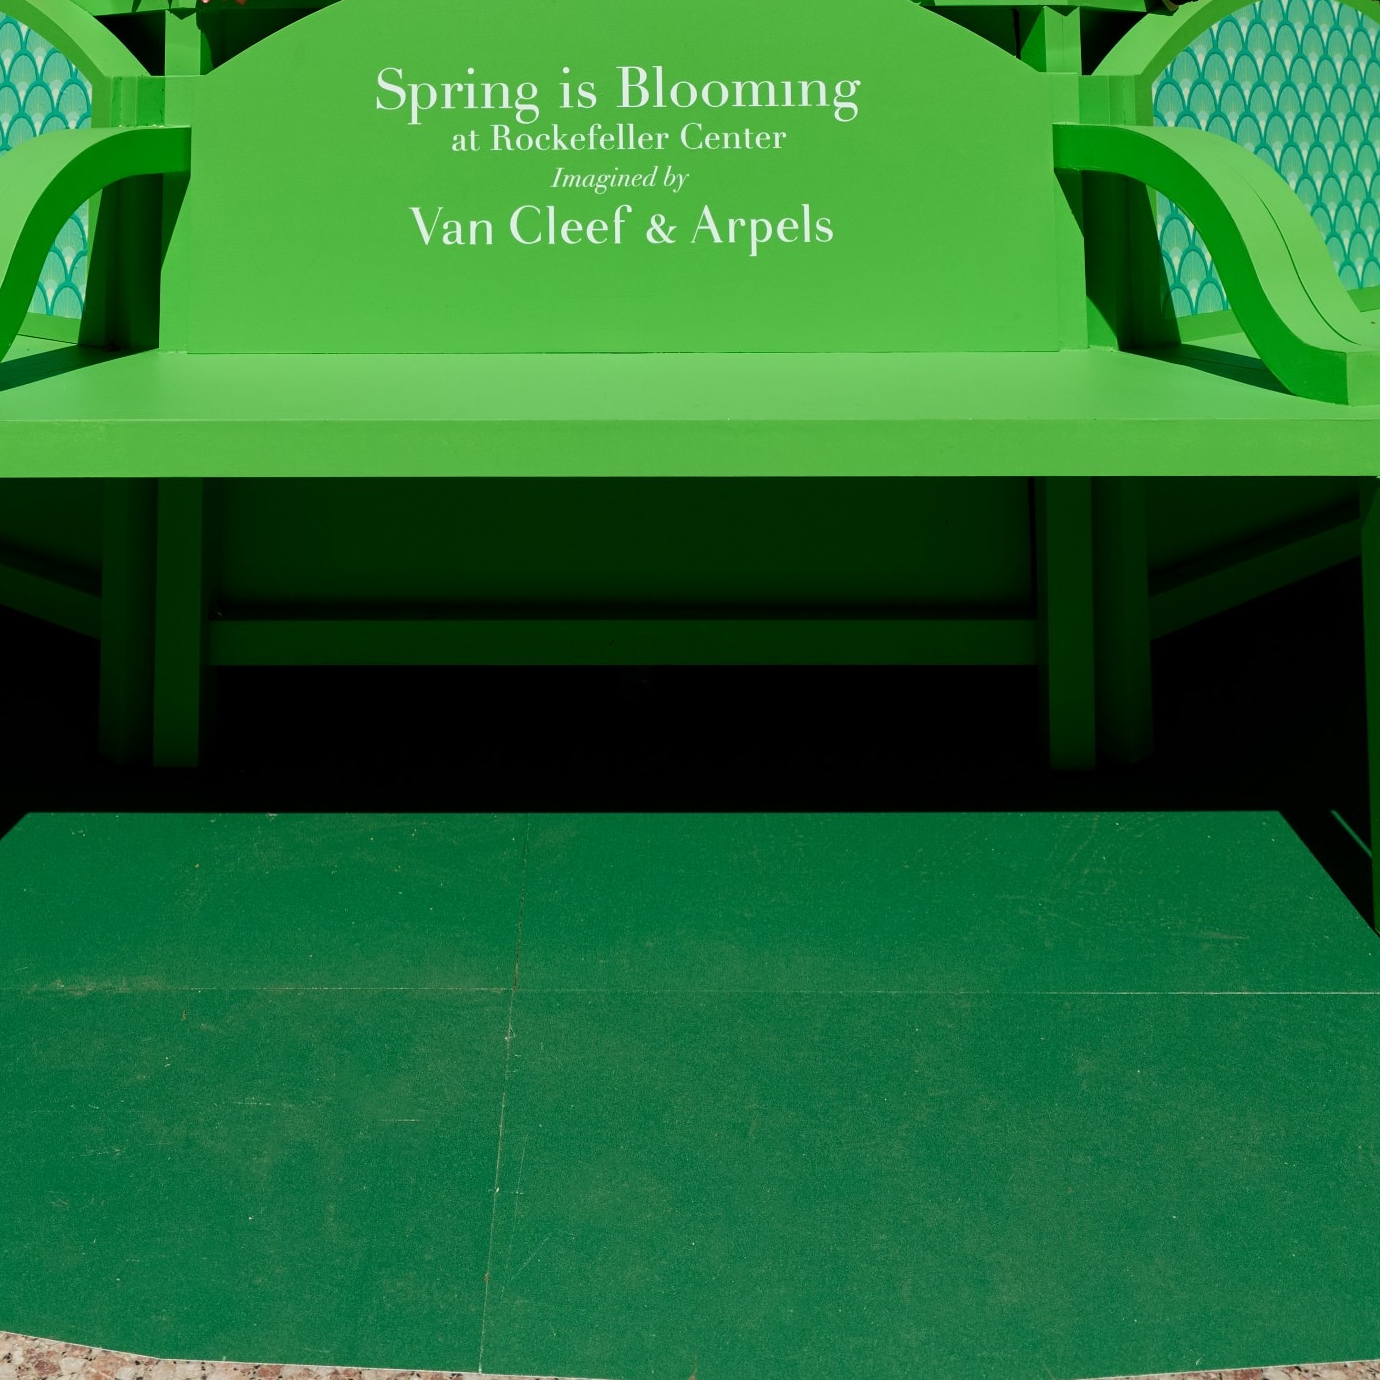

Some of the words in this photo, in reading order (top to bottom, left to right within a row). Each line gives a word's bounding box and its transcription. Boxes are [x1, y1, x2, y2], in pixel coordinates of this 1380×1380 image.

[376, 66, 540, 125] Spring
[559, 66, 597, 109] is
[615, 65, 862, 123] Blooming
[451, 128, 481, 152] at
[490, 123, 670, 151] Rockefeller
[679, 122, 787, 150] Center
[550, 165, 658, 195] Imagined
[662, 165, 689, 193] by
[408, 206, 493, 246] Van
[509, 204, 633, 245] Cleef
[645, 212, 677, 245] &
[690, 203, 834, 257] Arpels
